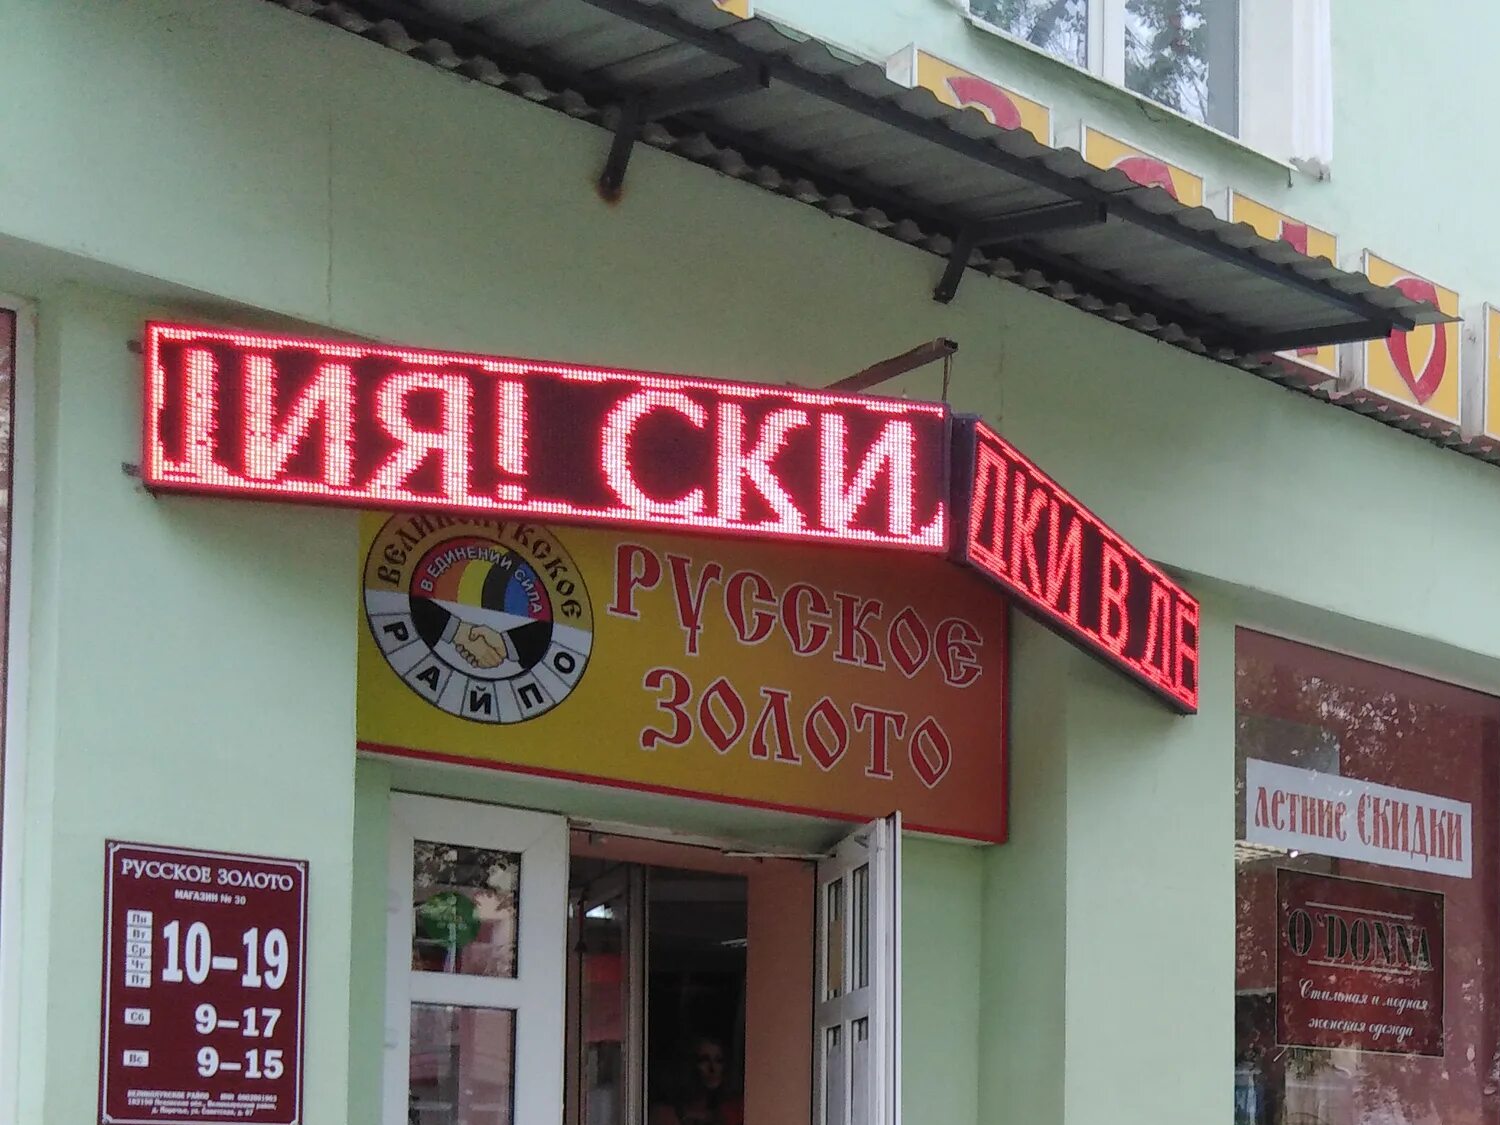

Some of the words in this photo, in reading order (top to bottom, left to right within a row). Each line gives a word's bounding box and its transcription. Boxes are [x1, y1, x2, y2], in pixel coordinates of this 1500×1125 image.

[420, 579, 433, 592] В
[427, 547, 513, 578] ЕДИНЕНИИ
[514, 569, 543, 614] СИЛА
[1101, 541, 1130, 656] В
[607, 543, 983, 688] РУССКОЕ
[383, 621, 576, 715] РАЙПО
[641, 668, 953, 788] ЗОЛОТО
[1357, 792, 1463, 863] СКИДКИ
[121, 858, 212, 883] РУССКОЕ
[217, 868, 294, 892] ЗОЛОТО
[174, 889, 218, 903] МАГАЗИН
[234, 895, 247, 906] 30
[162, 919, 289, 990] 10-19
[129, 1010, 145, 1022] Сб
[195, 1003, 282, 1038] 9-17
[1299, 978, 1369, 1004] Стильная
[1382, 996, 1428, 1016] модная
[128, 1052, 144, 1065] Вс
[196, 1046, 285, 1080] 9-15
[1368, 1022, 1414, 1043] одежда
